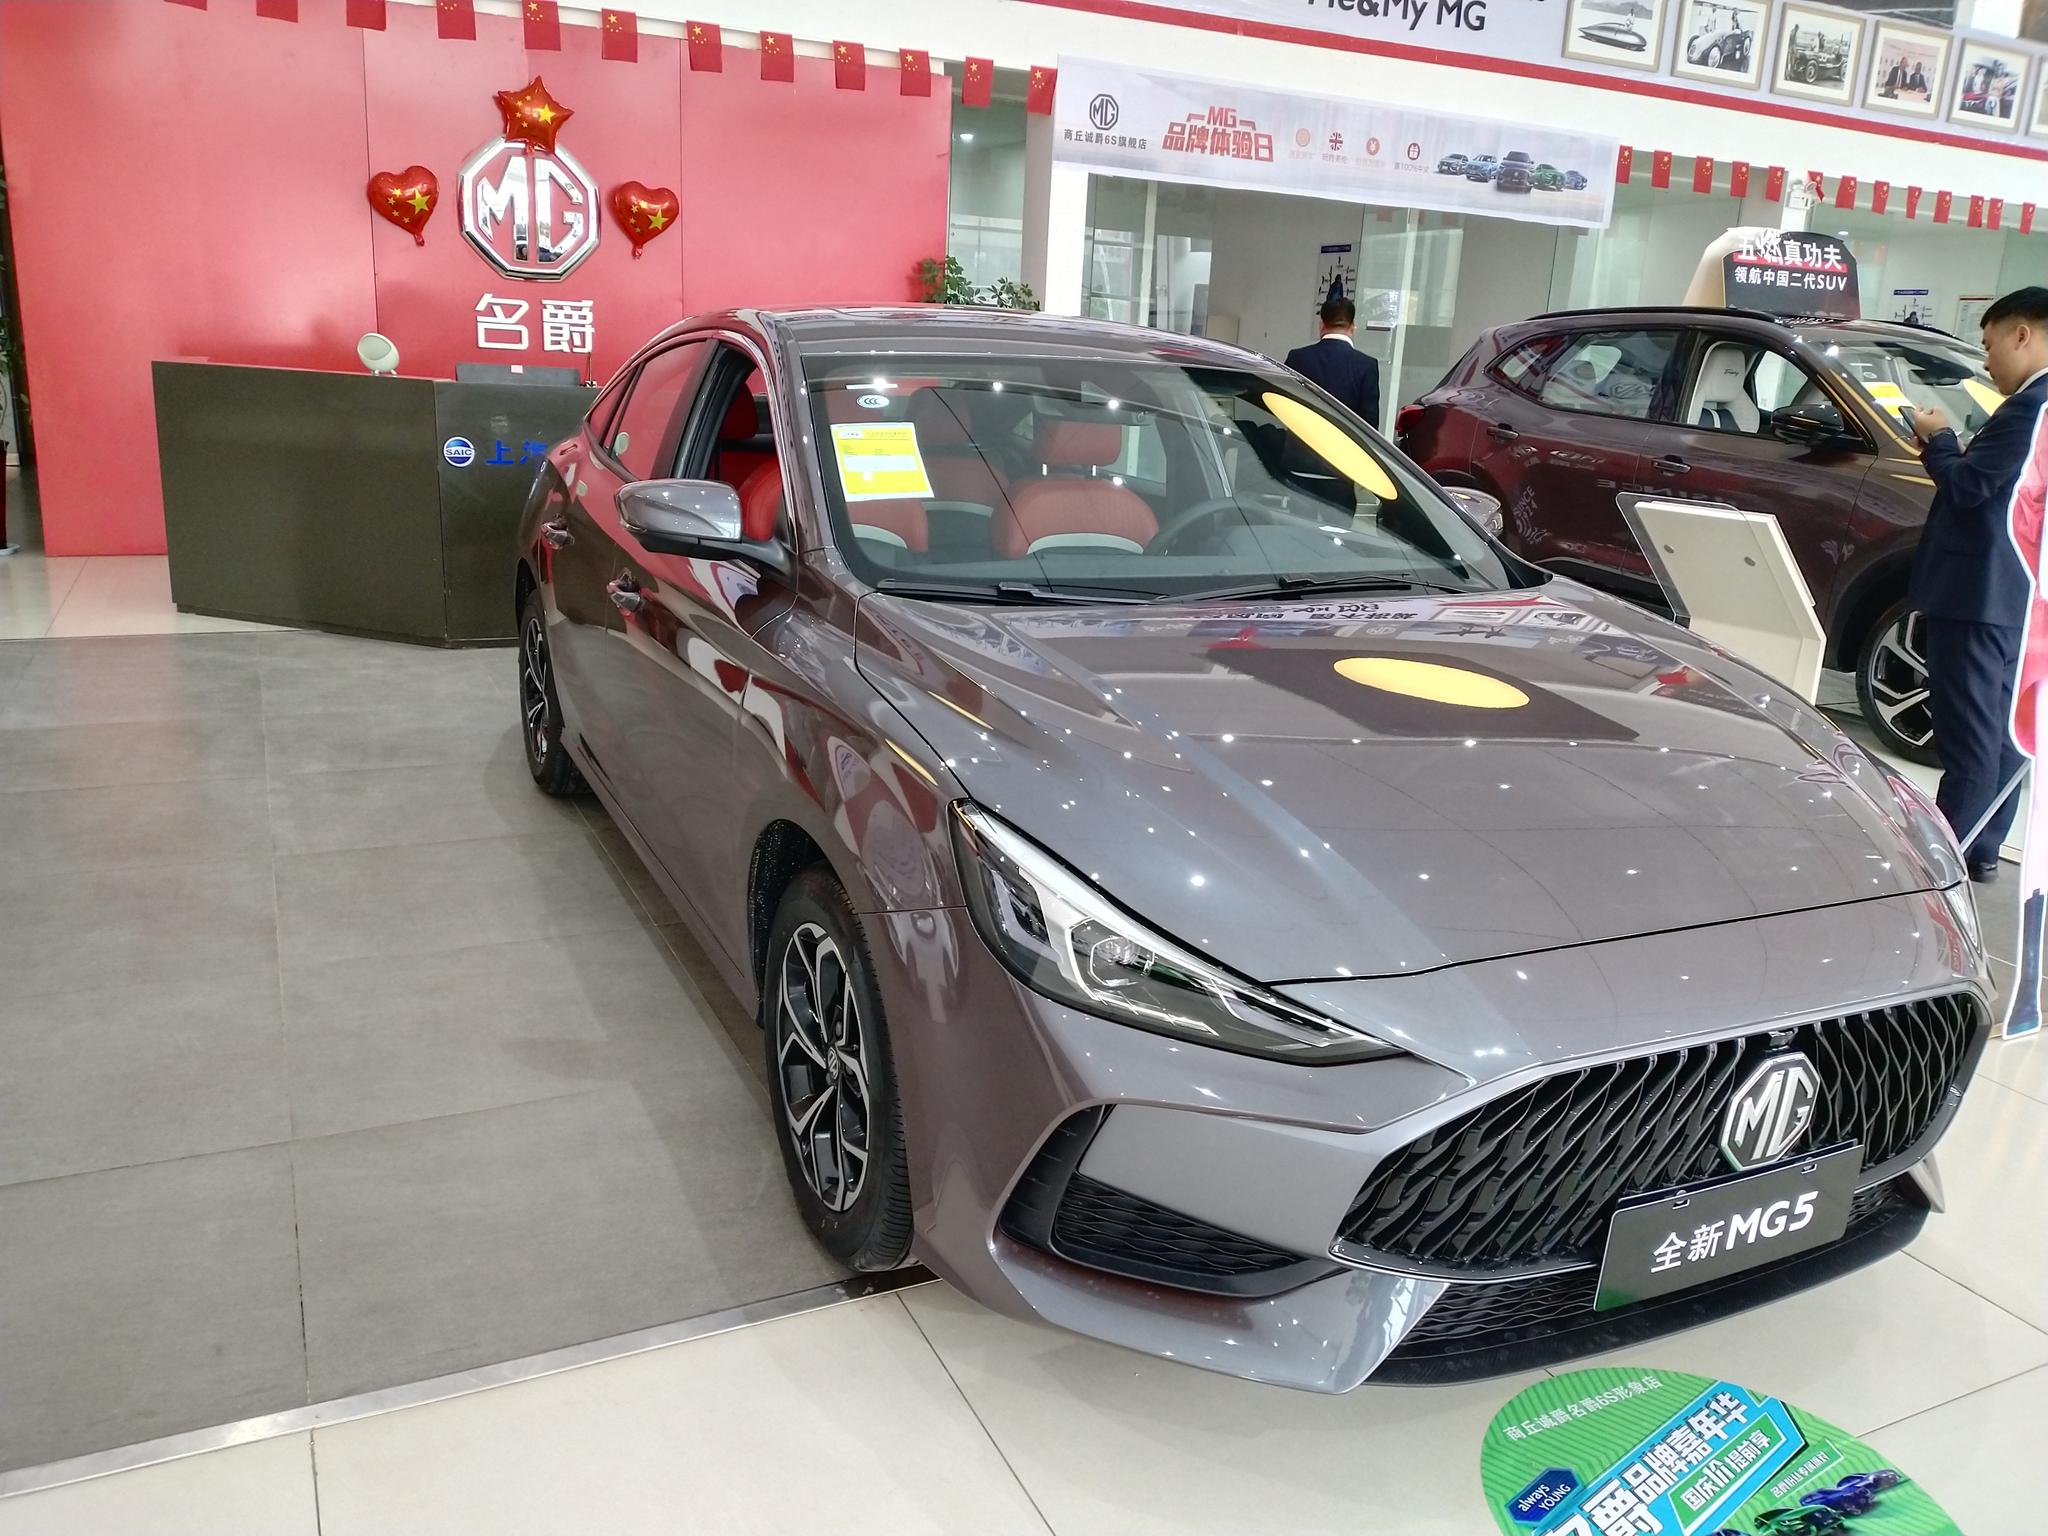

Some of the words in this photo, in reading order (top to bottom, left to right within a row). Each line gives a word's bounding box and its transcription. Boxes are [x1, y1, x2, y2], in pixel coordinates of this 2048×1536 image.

[1308, 0, 1428, 30] e&My
[1437, 0, 1487, 31] MG
[1092, 98, 1117, 126] MG
[1207, 106, 1237, 128] MG
[1063, 129, 1148, 150] 商丘诚爵6S旗舰店
[1162, 122, 1274, 162] 品牌体验日
[476, 156, 583, 263] MG
[1734, 265, 1848, 292] 领航中国二代SUV
[475, 293, 595, 353] 名爵
[445, 448, 473, 456] SAIC
[1734, 1066, 1814, 1161] MG
[1650, 1191, 1819, 1273] 全新MG5
[1503, 1375, 1663, 1441] 商丘诚爵名爵6S形象店
[1518, 1483, 1550, 1512] always
[1538, 1483, 1571, 1511] YOUNG
